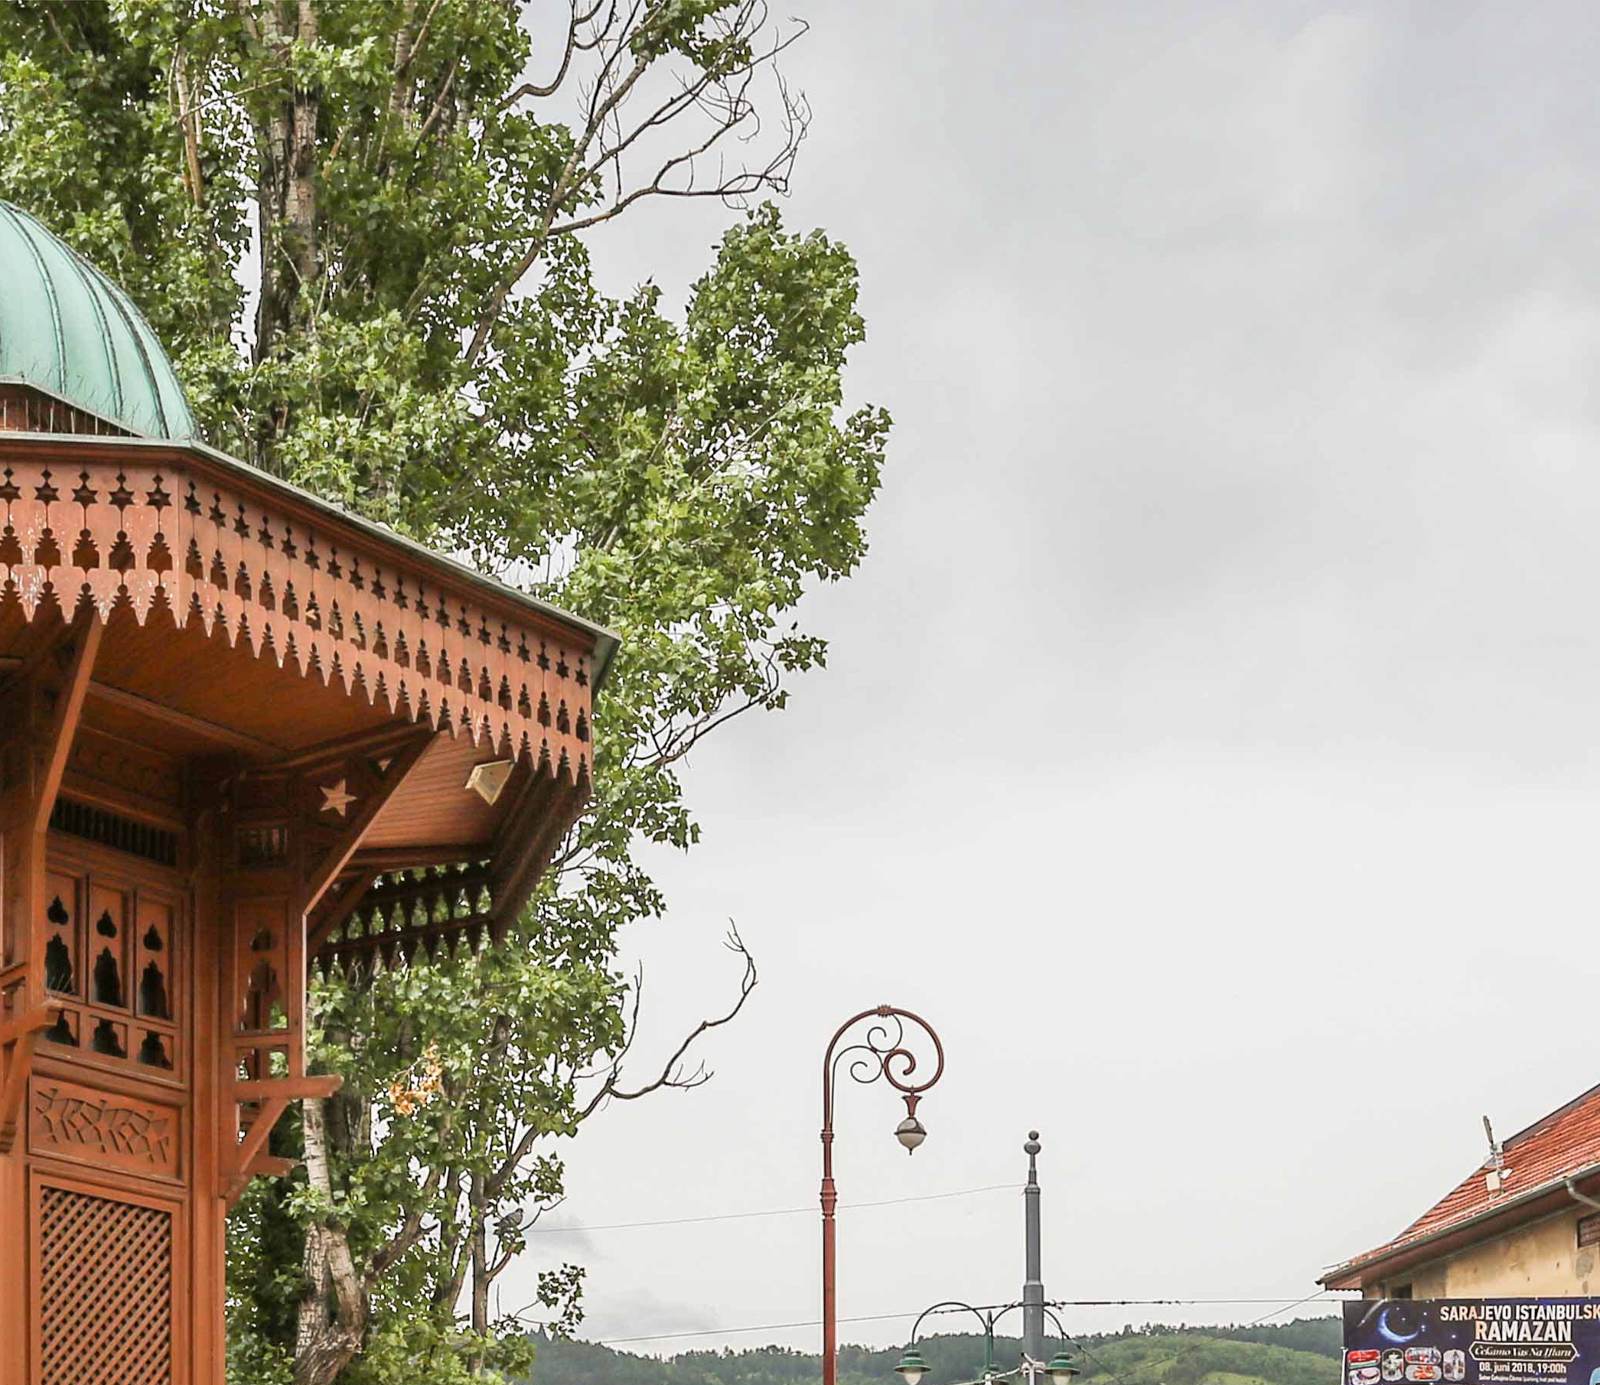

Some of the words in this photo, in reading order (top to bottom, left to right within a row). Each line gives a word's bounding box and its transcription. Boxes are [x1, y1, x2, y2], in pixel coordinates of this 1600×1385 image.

[1440, 1305, 1511, 1321] SARAJEVO
[1475, 1321, 1571, 1342] RAMAZAN
[1479, 1362, 1492, 1372] 08.
[1494, 1362, 1510, 1374] juni
[1511, 1362, 1535, 1374] 2018,
[1538, 1363, 1567, 1374] 19:00h
